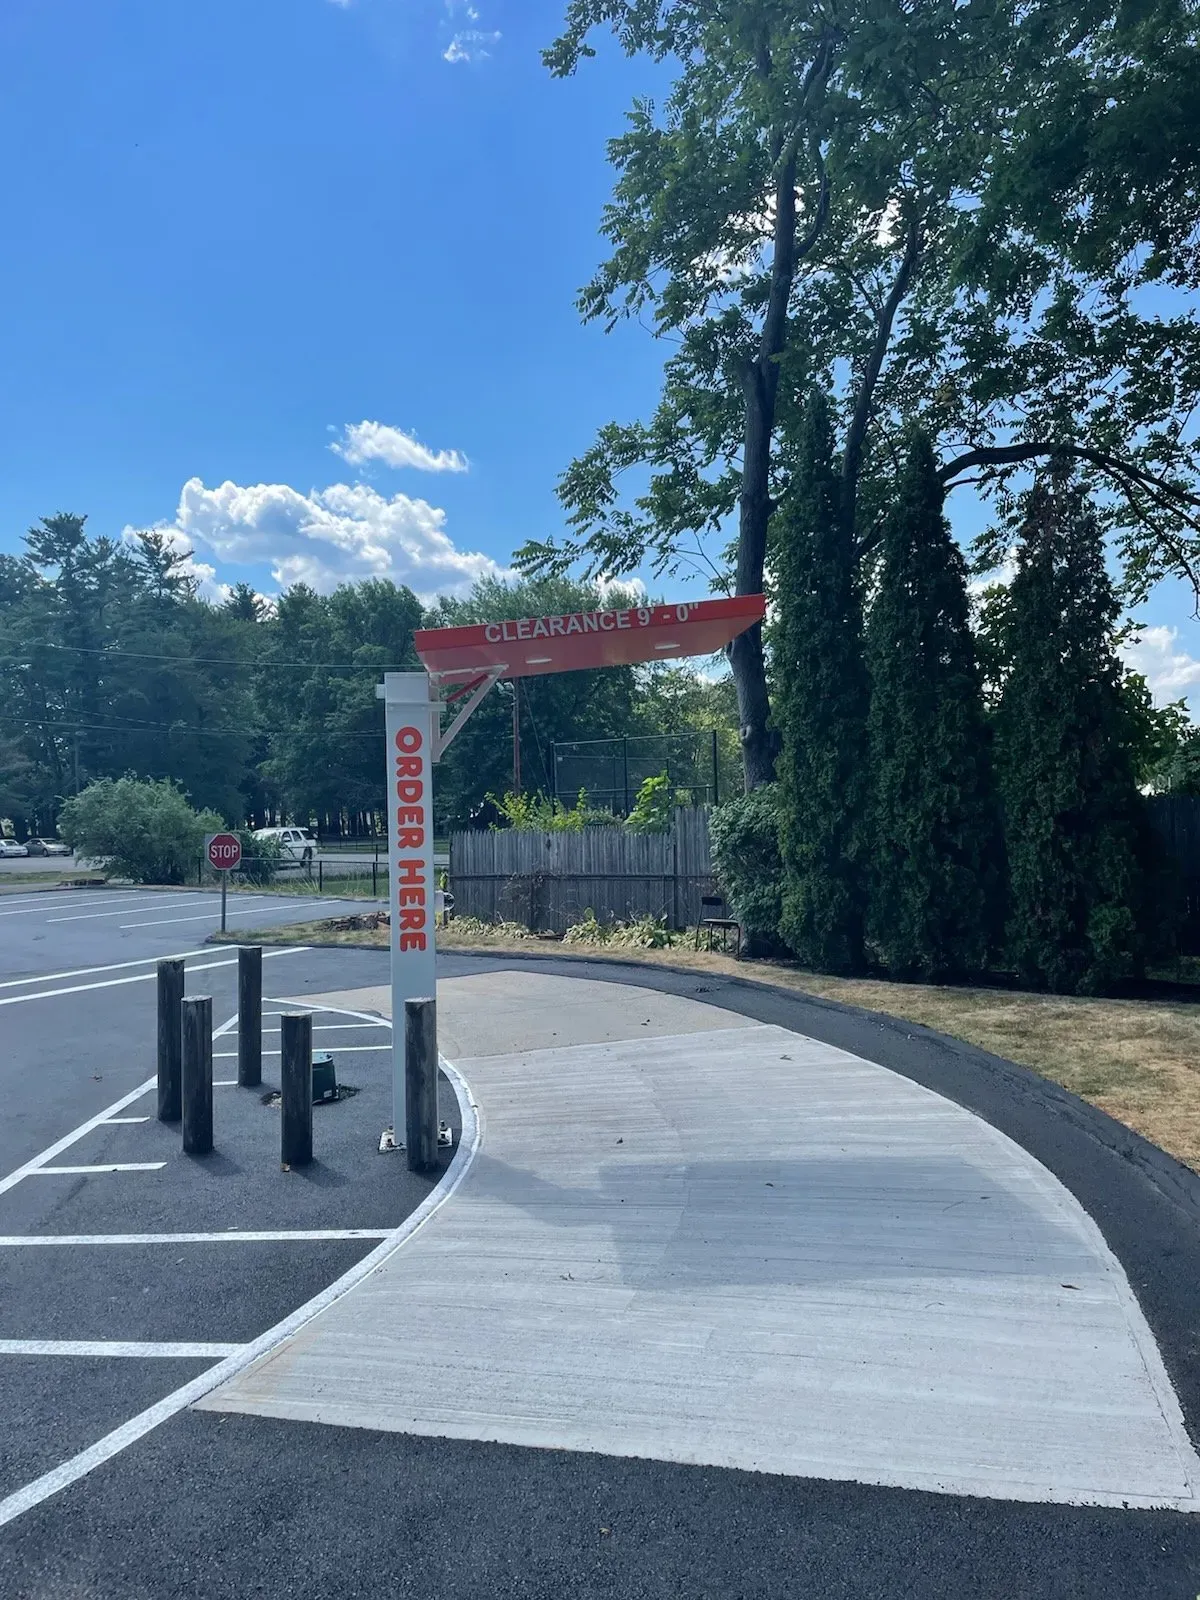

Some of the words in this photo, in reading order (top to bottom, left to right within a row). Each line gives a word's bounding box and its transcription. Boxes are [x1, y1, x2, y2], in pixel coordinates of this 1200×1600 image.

[485, 610, 631, 642] CLEARANCE
[638, 607, 655, 626] 9'
[395, 726, 424, 849] ORDER
[211, 845, 238, 858] STOP
[398, 859, 427, 953] HERE
